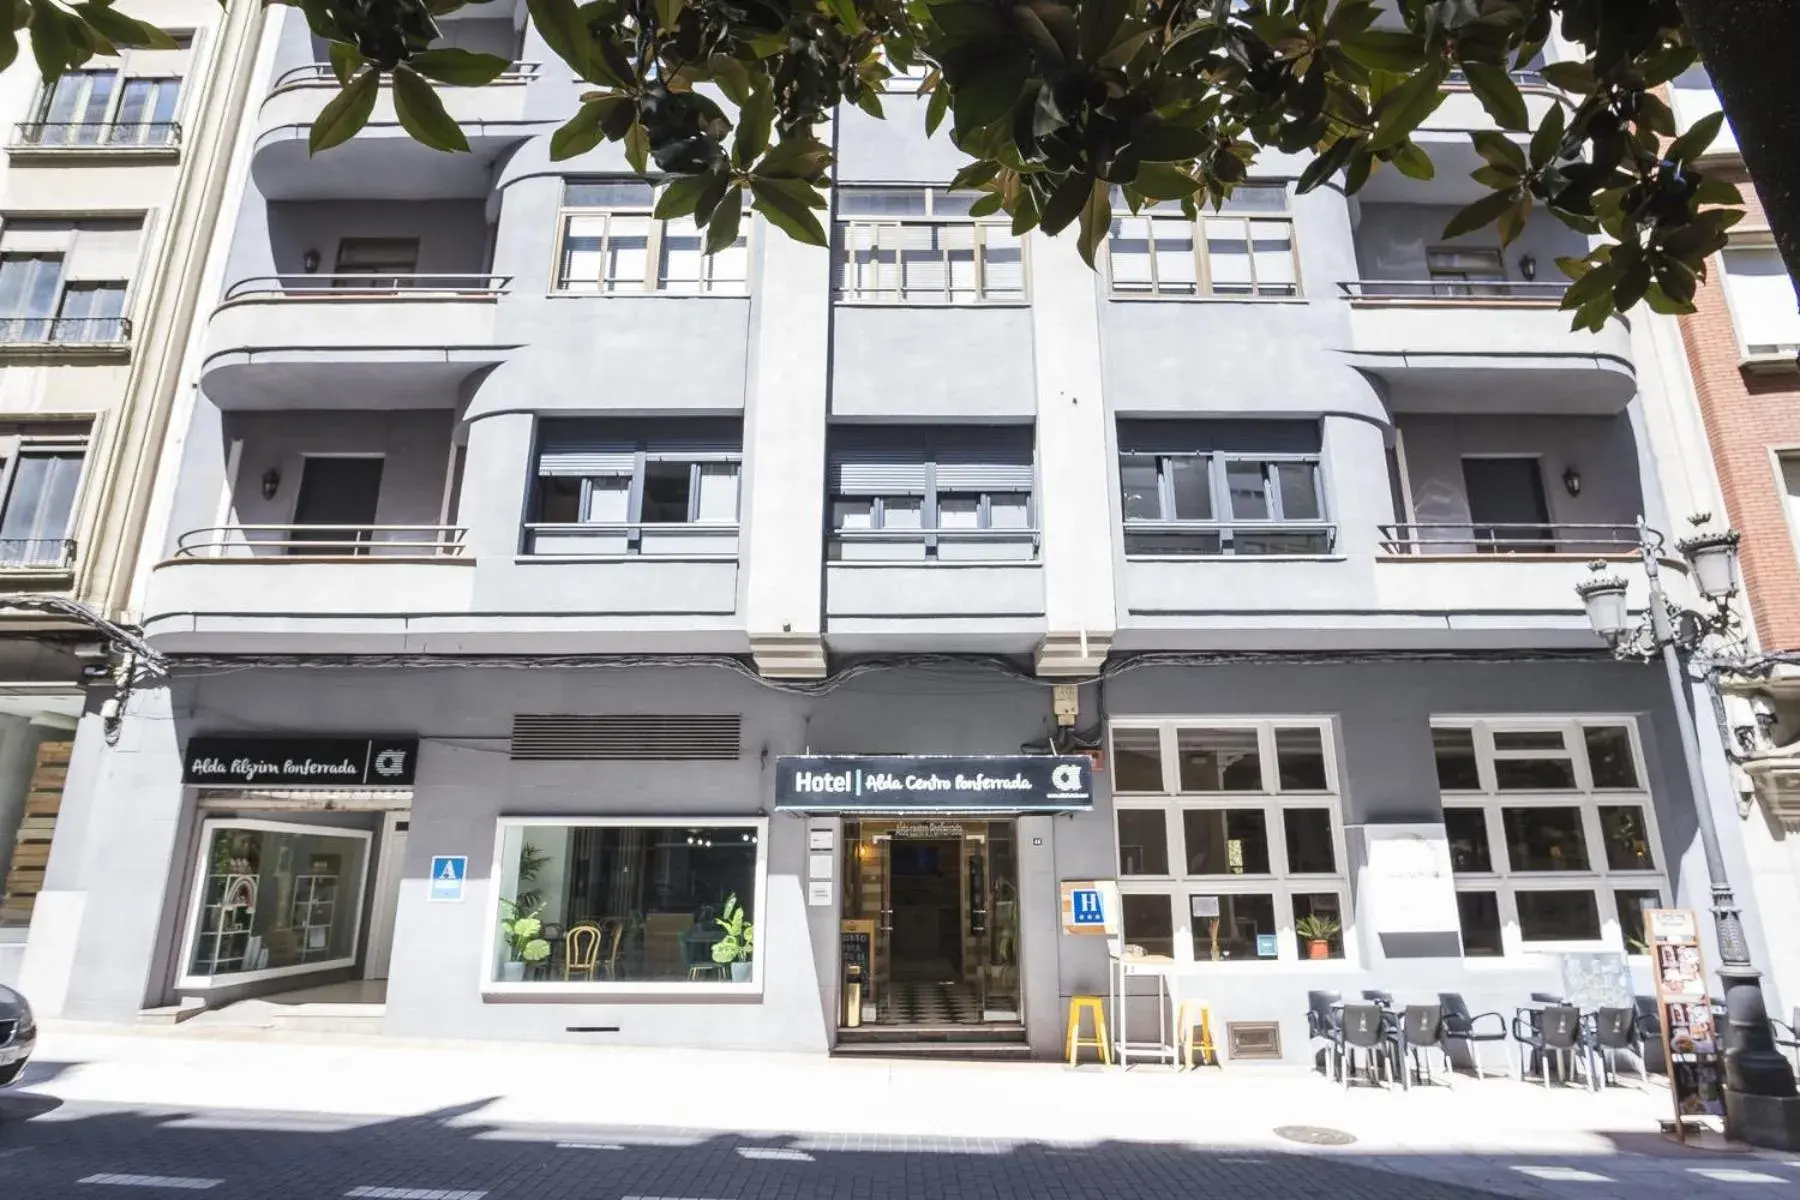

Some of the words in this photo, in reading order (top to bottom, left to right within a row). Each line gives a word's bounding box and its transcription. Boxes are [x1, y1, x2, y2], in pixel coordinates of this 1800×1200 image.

[191, 758, 226, 775] Alda
[230, 758, 279, 781] Pilgrim
[283, 758, 357, 775] Ponferrada
[795, 770, 851, 792] Hotel
[865, 773, 903, 792] Alda
[905, 773, 951, 791] Centro
[955, 772, 1033, 791] Ponferrada
[439, 859, 456, 880] A
[1081, 893, 1098, 912] H
